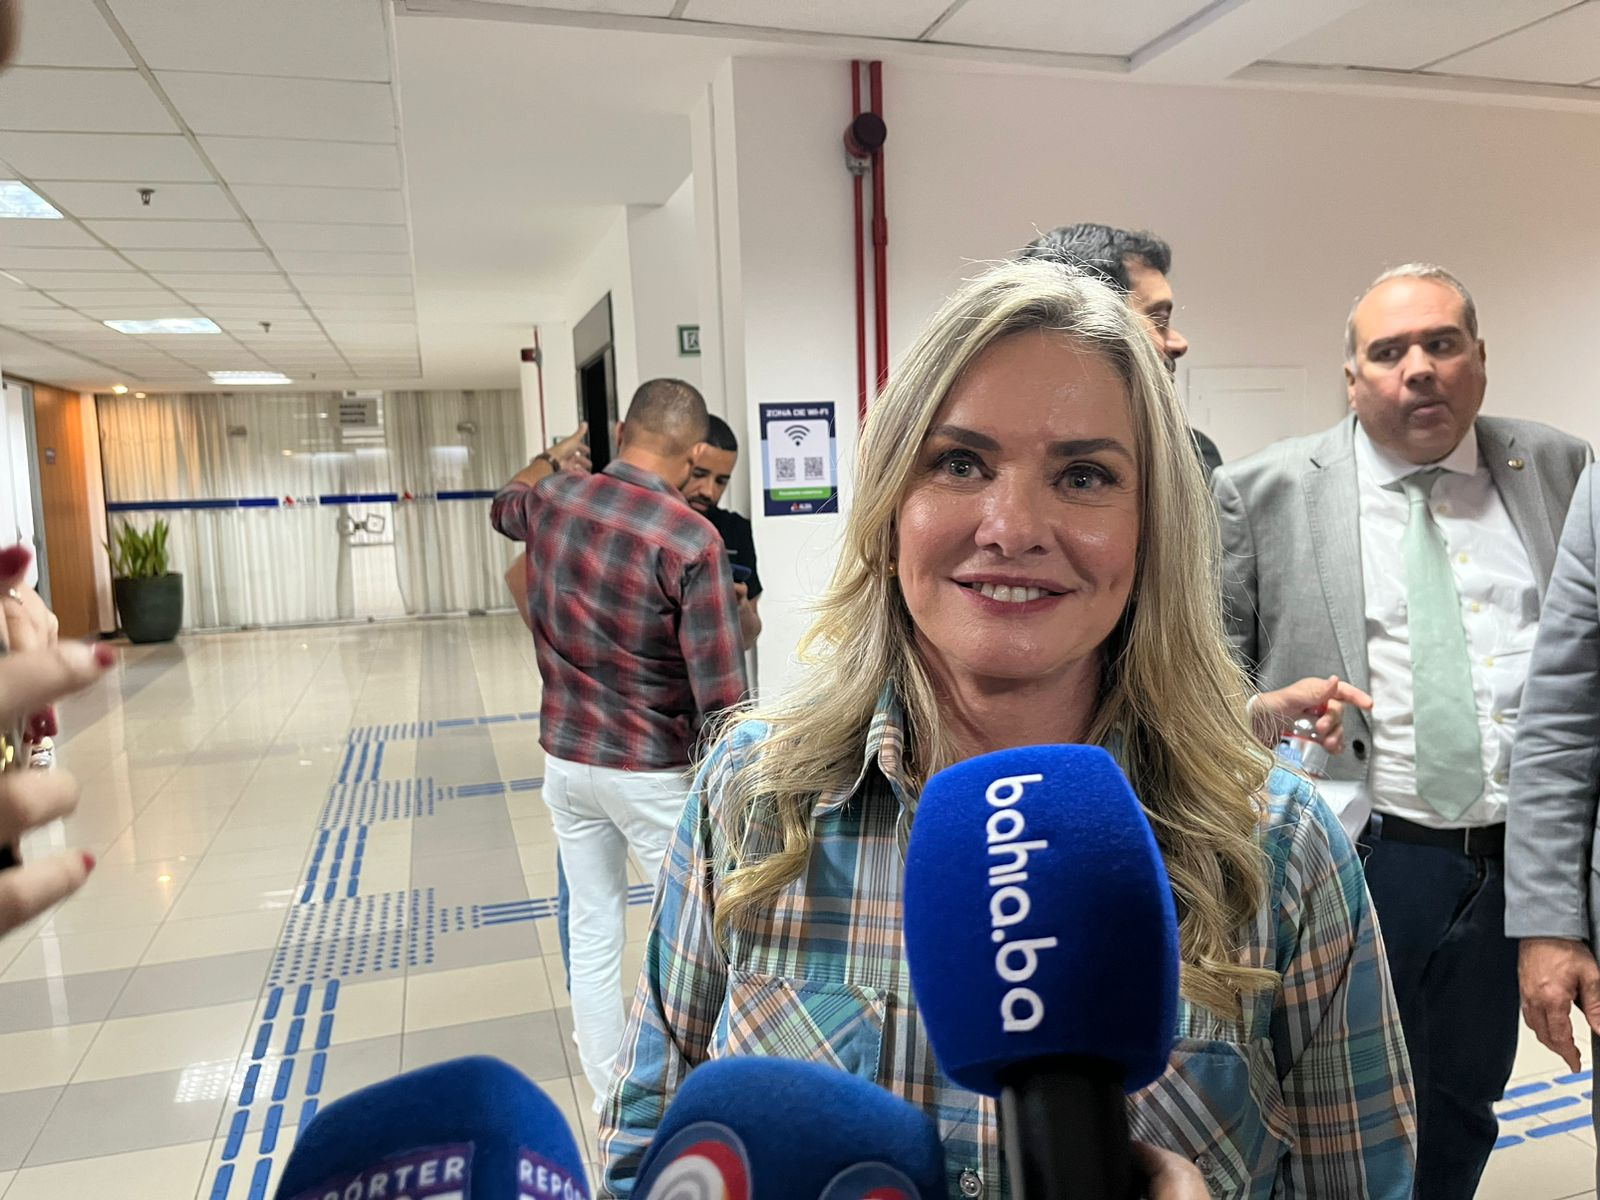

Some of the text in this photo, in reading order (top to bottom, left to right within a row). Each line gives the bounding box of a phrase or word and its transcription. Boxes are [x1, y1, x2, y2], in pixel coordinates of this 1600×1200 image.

[766, 408, 792, 417] ZONA
[792, 408, 806, 417] DE
[985, 773, 1058, 1032] bahia.ba
